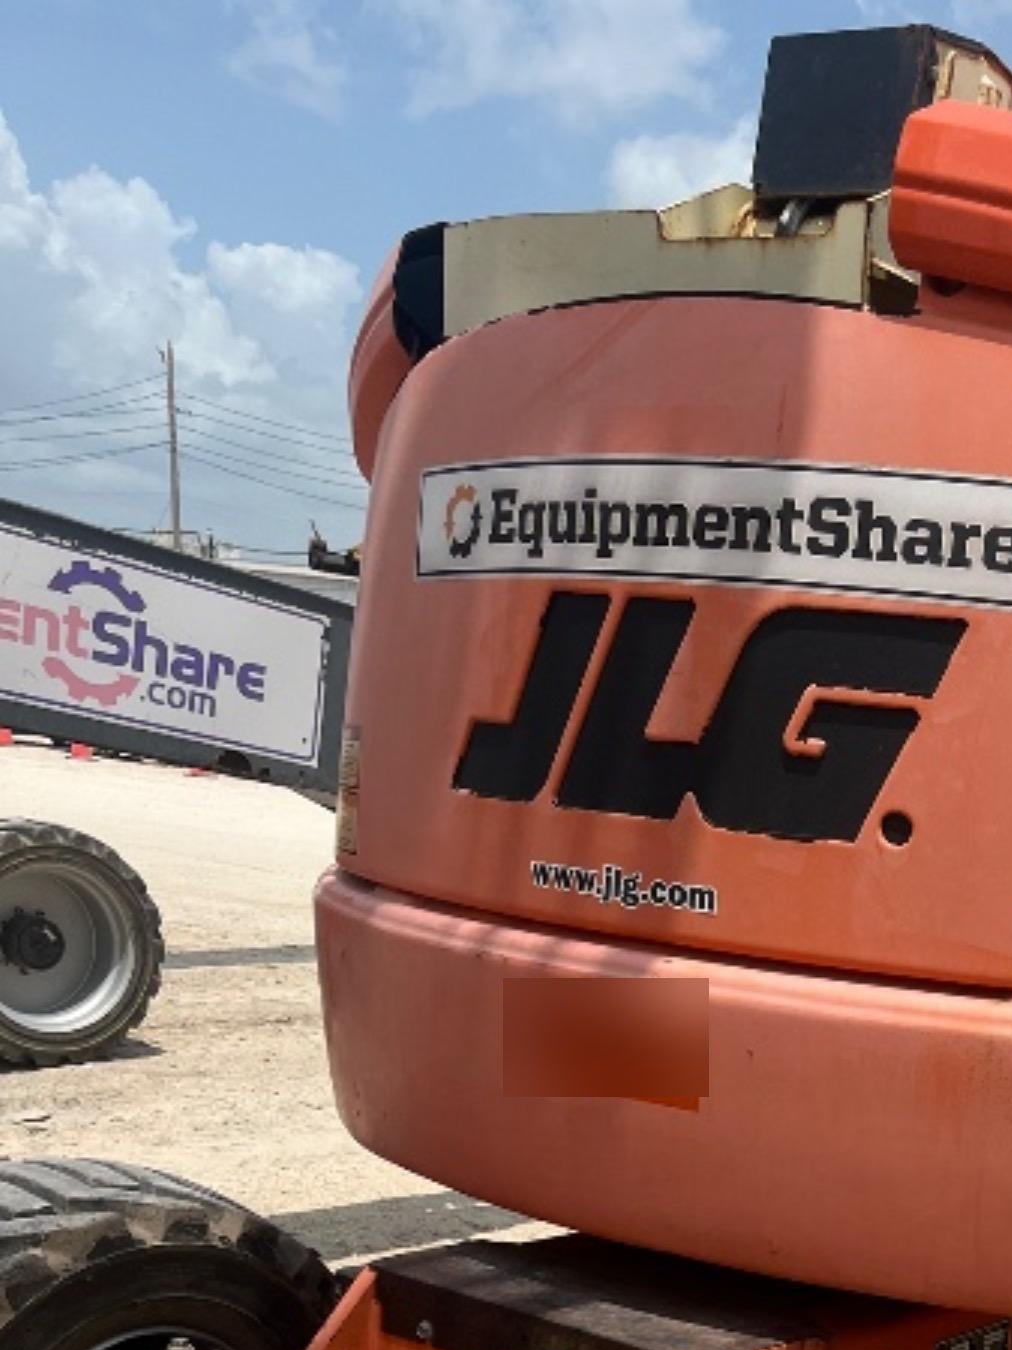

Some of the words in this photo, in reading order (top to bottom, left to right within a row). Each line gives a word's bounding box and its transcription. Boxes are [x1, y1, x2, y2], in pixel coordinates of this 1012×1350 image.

[140, 682, 217, 718] .com
[451, 591, 969, 844] JLG
[531, 860, 716, 913] www.jlg.com
